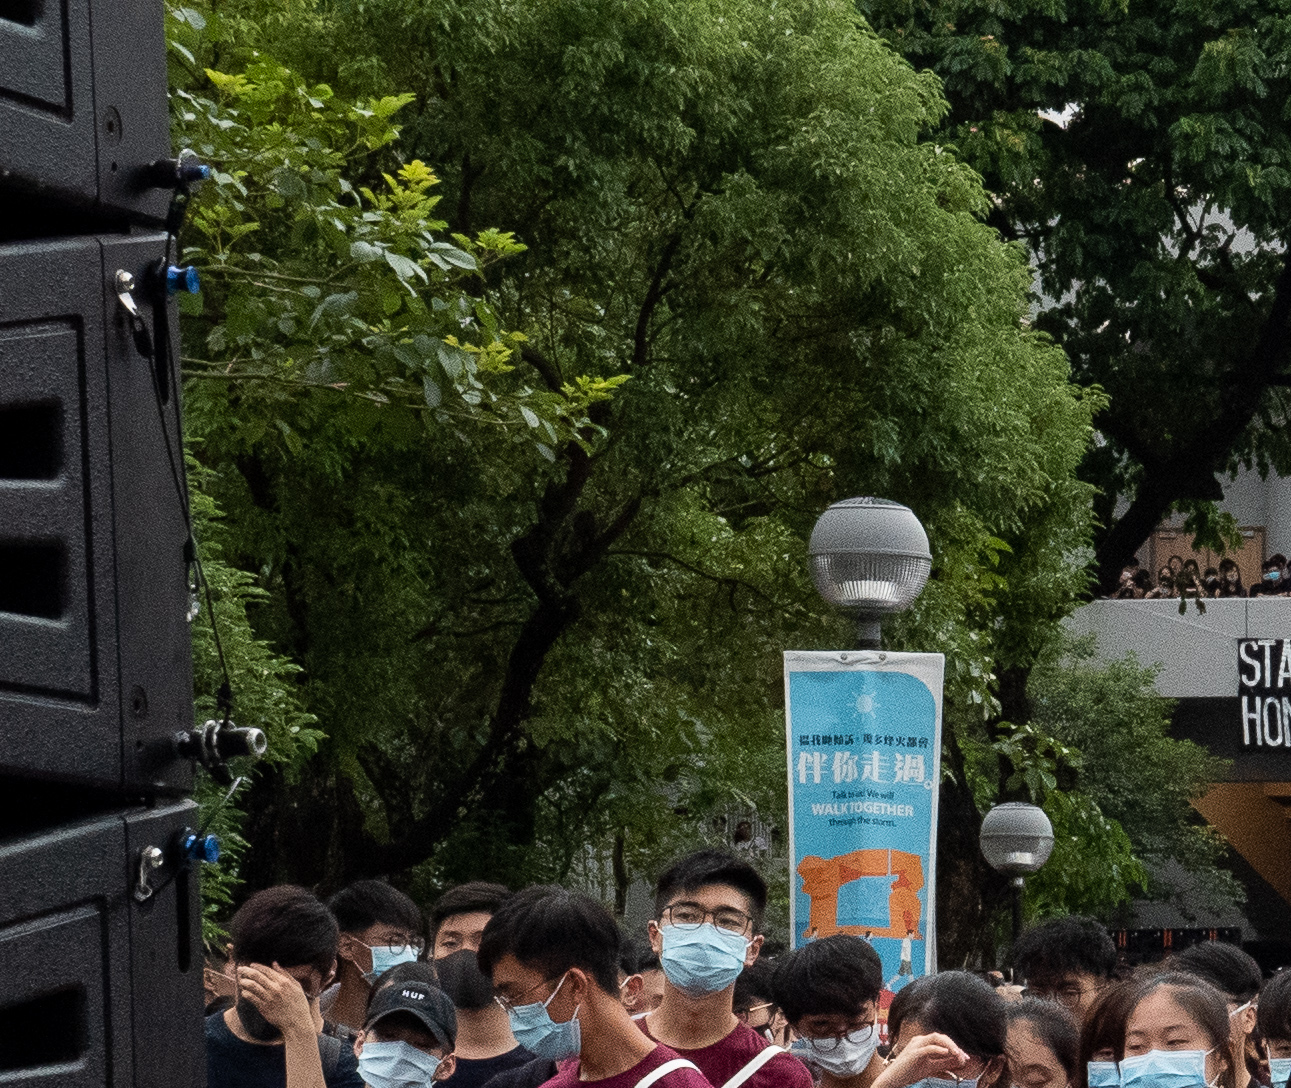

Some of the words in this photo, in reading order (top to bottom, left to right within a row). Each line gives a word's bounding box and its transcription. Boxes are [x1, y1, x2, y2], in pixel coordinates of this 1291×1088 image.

[811, 802, 849, 817] WALK
[849, 801, 914, 817] TOGETHER
[856, 816, 871, 825] the
[401, 989, 425, 1001] HUF
